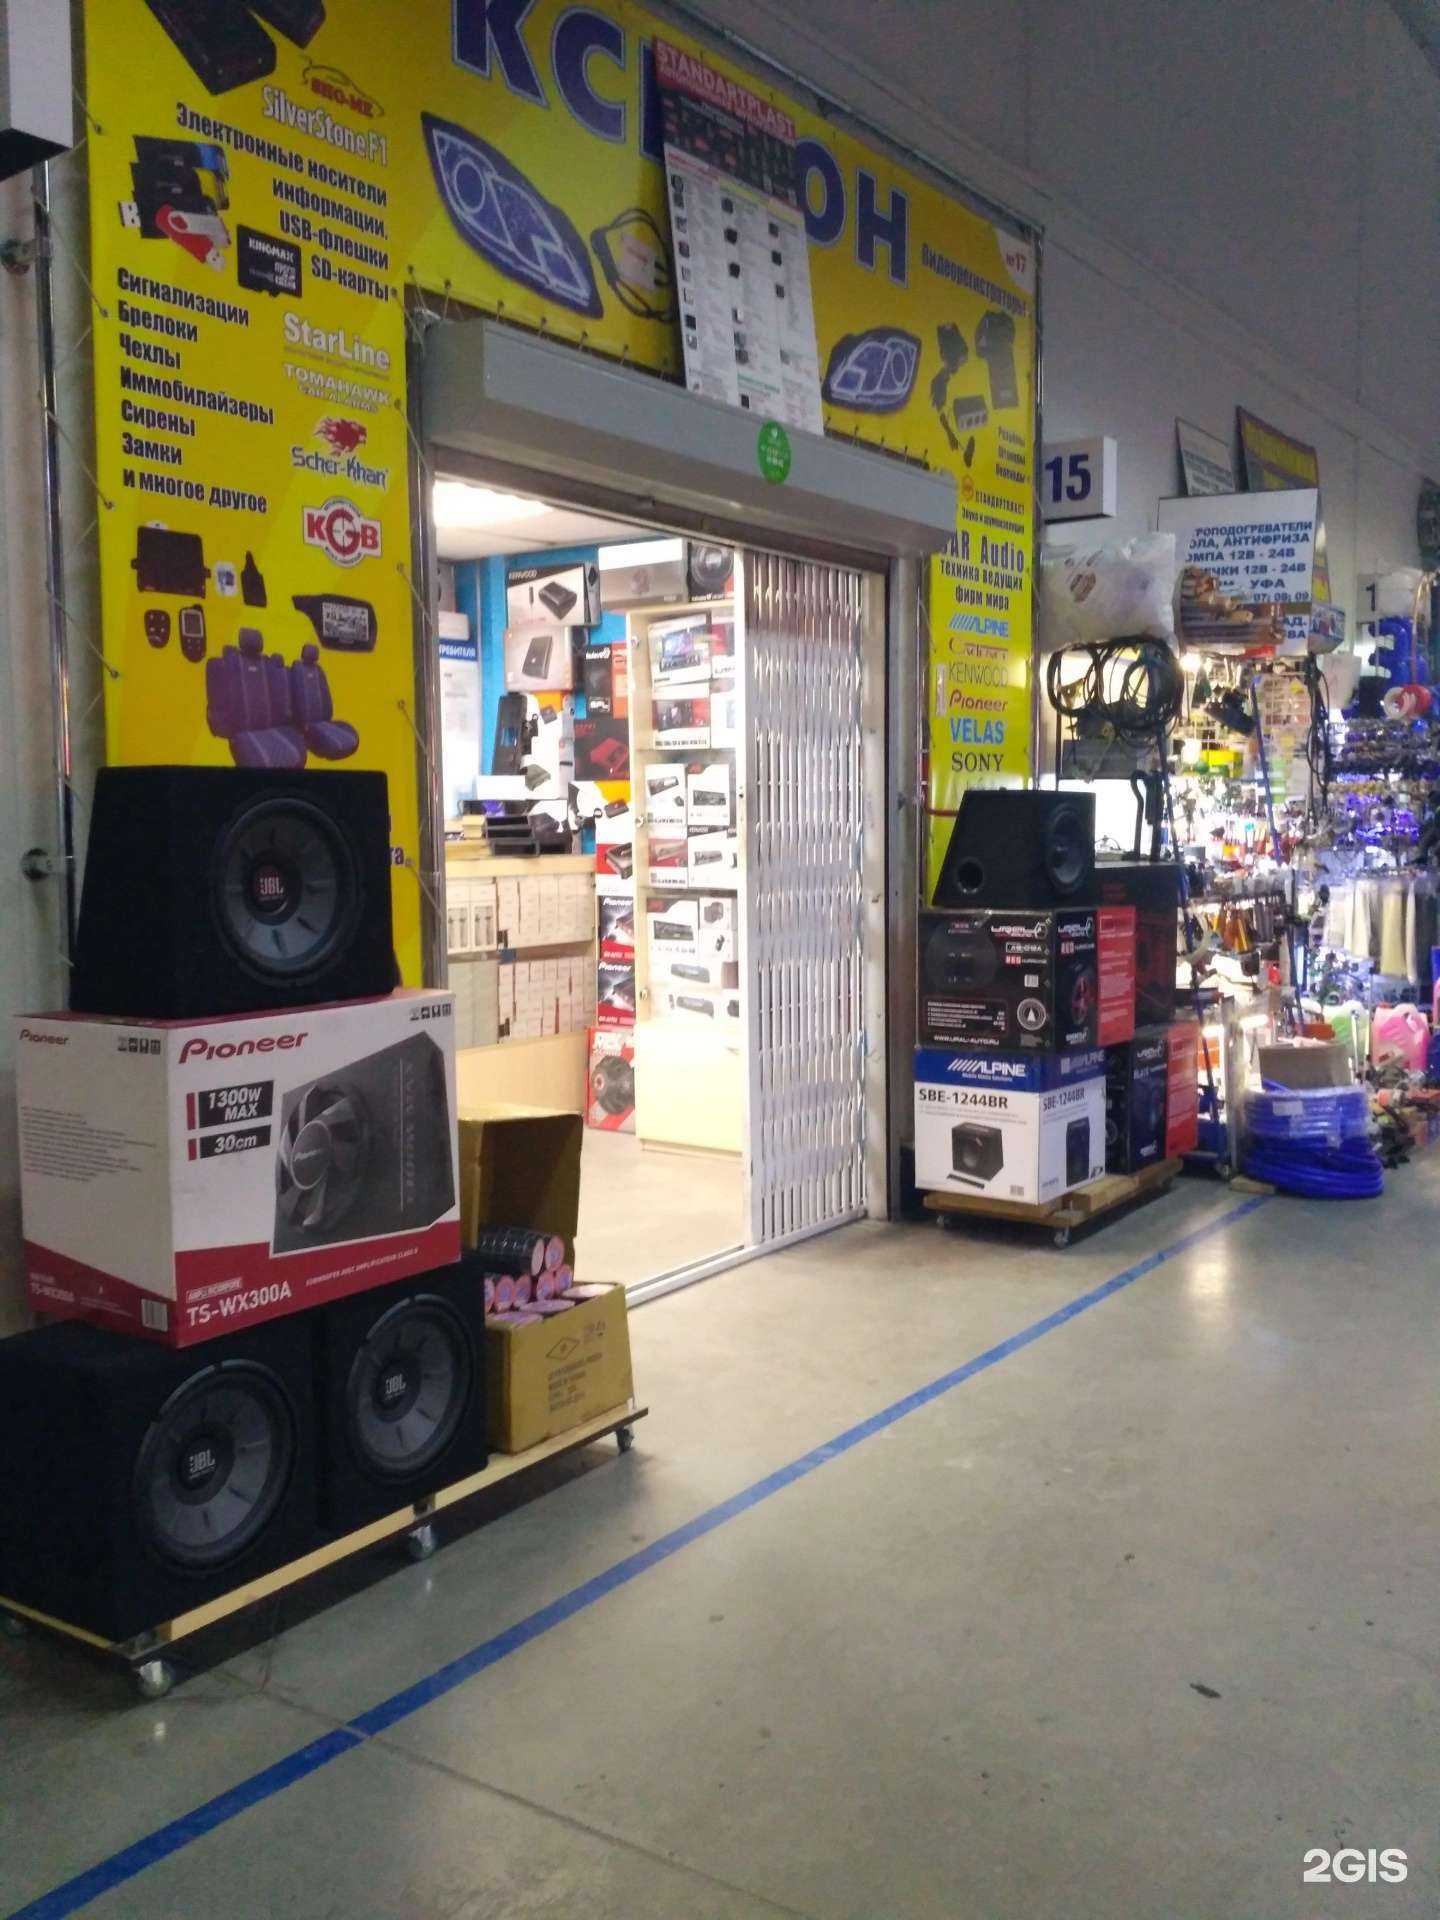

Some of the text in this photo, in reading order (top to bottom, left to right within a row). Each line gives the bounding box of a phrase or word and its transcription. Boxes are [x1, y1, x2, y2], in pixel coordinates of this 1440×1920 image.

[176, 101, 388, 207] Электронные носители
[279, 209, 389, 270] USB-флешки
[311, 255, 389, 301] SD-карты
[117, 267, 249, 327] Сигнализации
[118, 299, 198, 342] Брелоки
[119, 332, 181, 370] Чехлы
[283, 311, 391, 371] StarLine
[120, 366, 274, 425] Иммобилайзеры
[121, 399, 196, 437] Сирены
[122, 432, 182, 466] Замки
[291, 446, 388, 490] Scher-Khan
[1045, 454, 1092, 503] 15
[123, 470, 267, 515] и многое другое
[306, 508, 379, 558] KGB
[1223, 533, 1310, 547] АНТИФРИЗА
[942, 530, 1024, 574] AR Audio
[940, 559, 1024, 592] техника ведущих
[1250, 579, 1286, 589] УФА
[955, 585, 1010, 612] фирм мира
[948, 661, 1009, 688] KENWOOD
[949, 689, 1009, 713] Pioneer
[950, 717, 1006, 744] VELAS
[951, 751, 1005, 772] SONY
[260, 877, 284, 895] JBL
[19, 1028, 69, 1046] Pioneer
[178, 1032, 309, 1064] Pioneer
[947, 1058, 1027, 1078] ALPINE
[224, 1102, 258, 1122] MAX
[918, 1088, 1009, 1110] SBE-1244BR
[214, 1134, 257, 1153] 30cm
[186, 1280, 292, 1327] TS-WX300A
[387, 1373, 406, 1393] JBL
[189, 1449, 216, 1472] JBL
